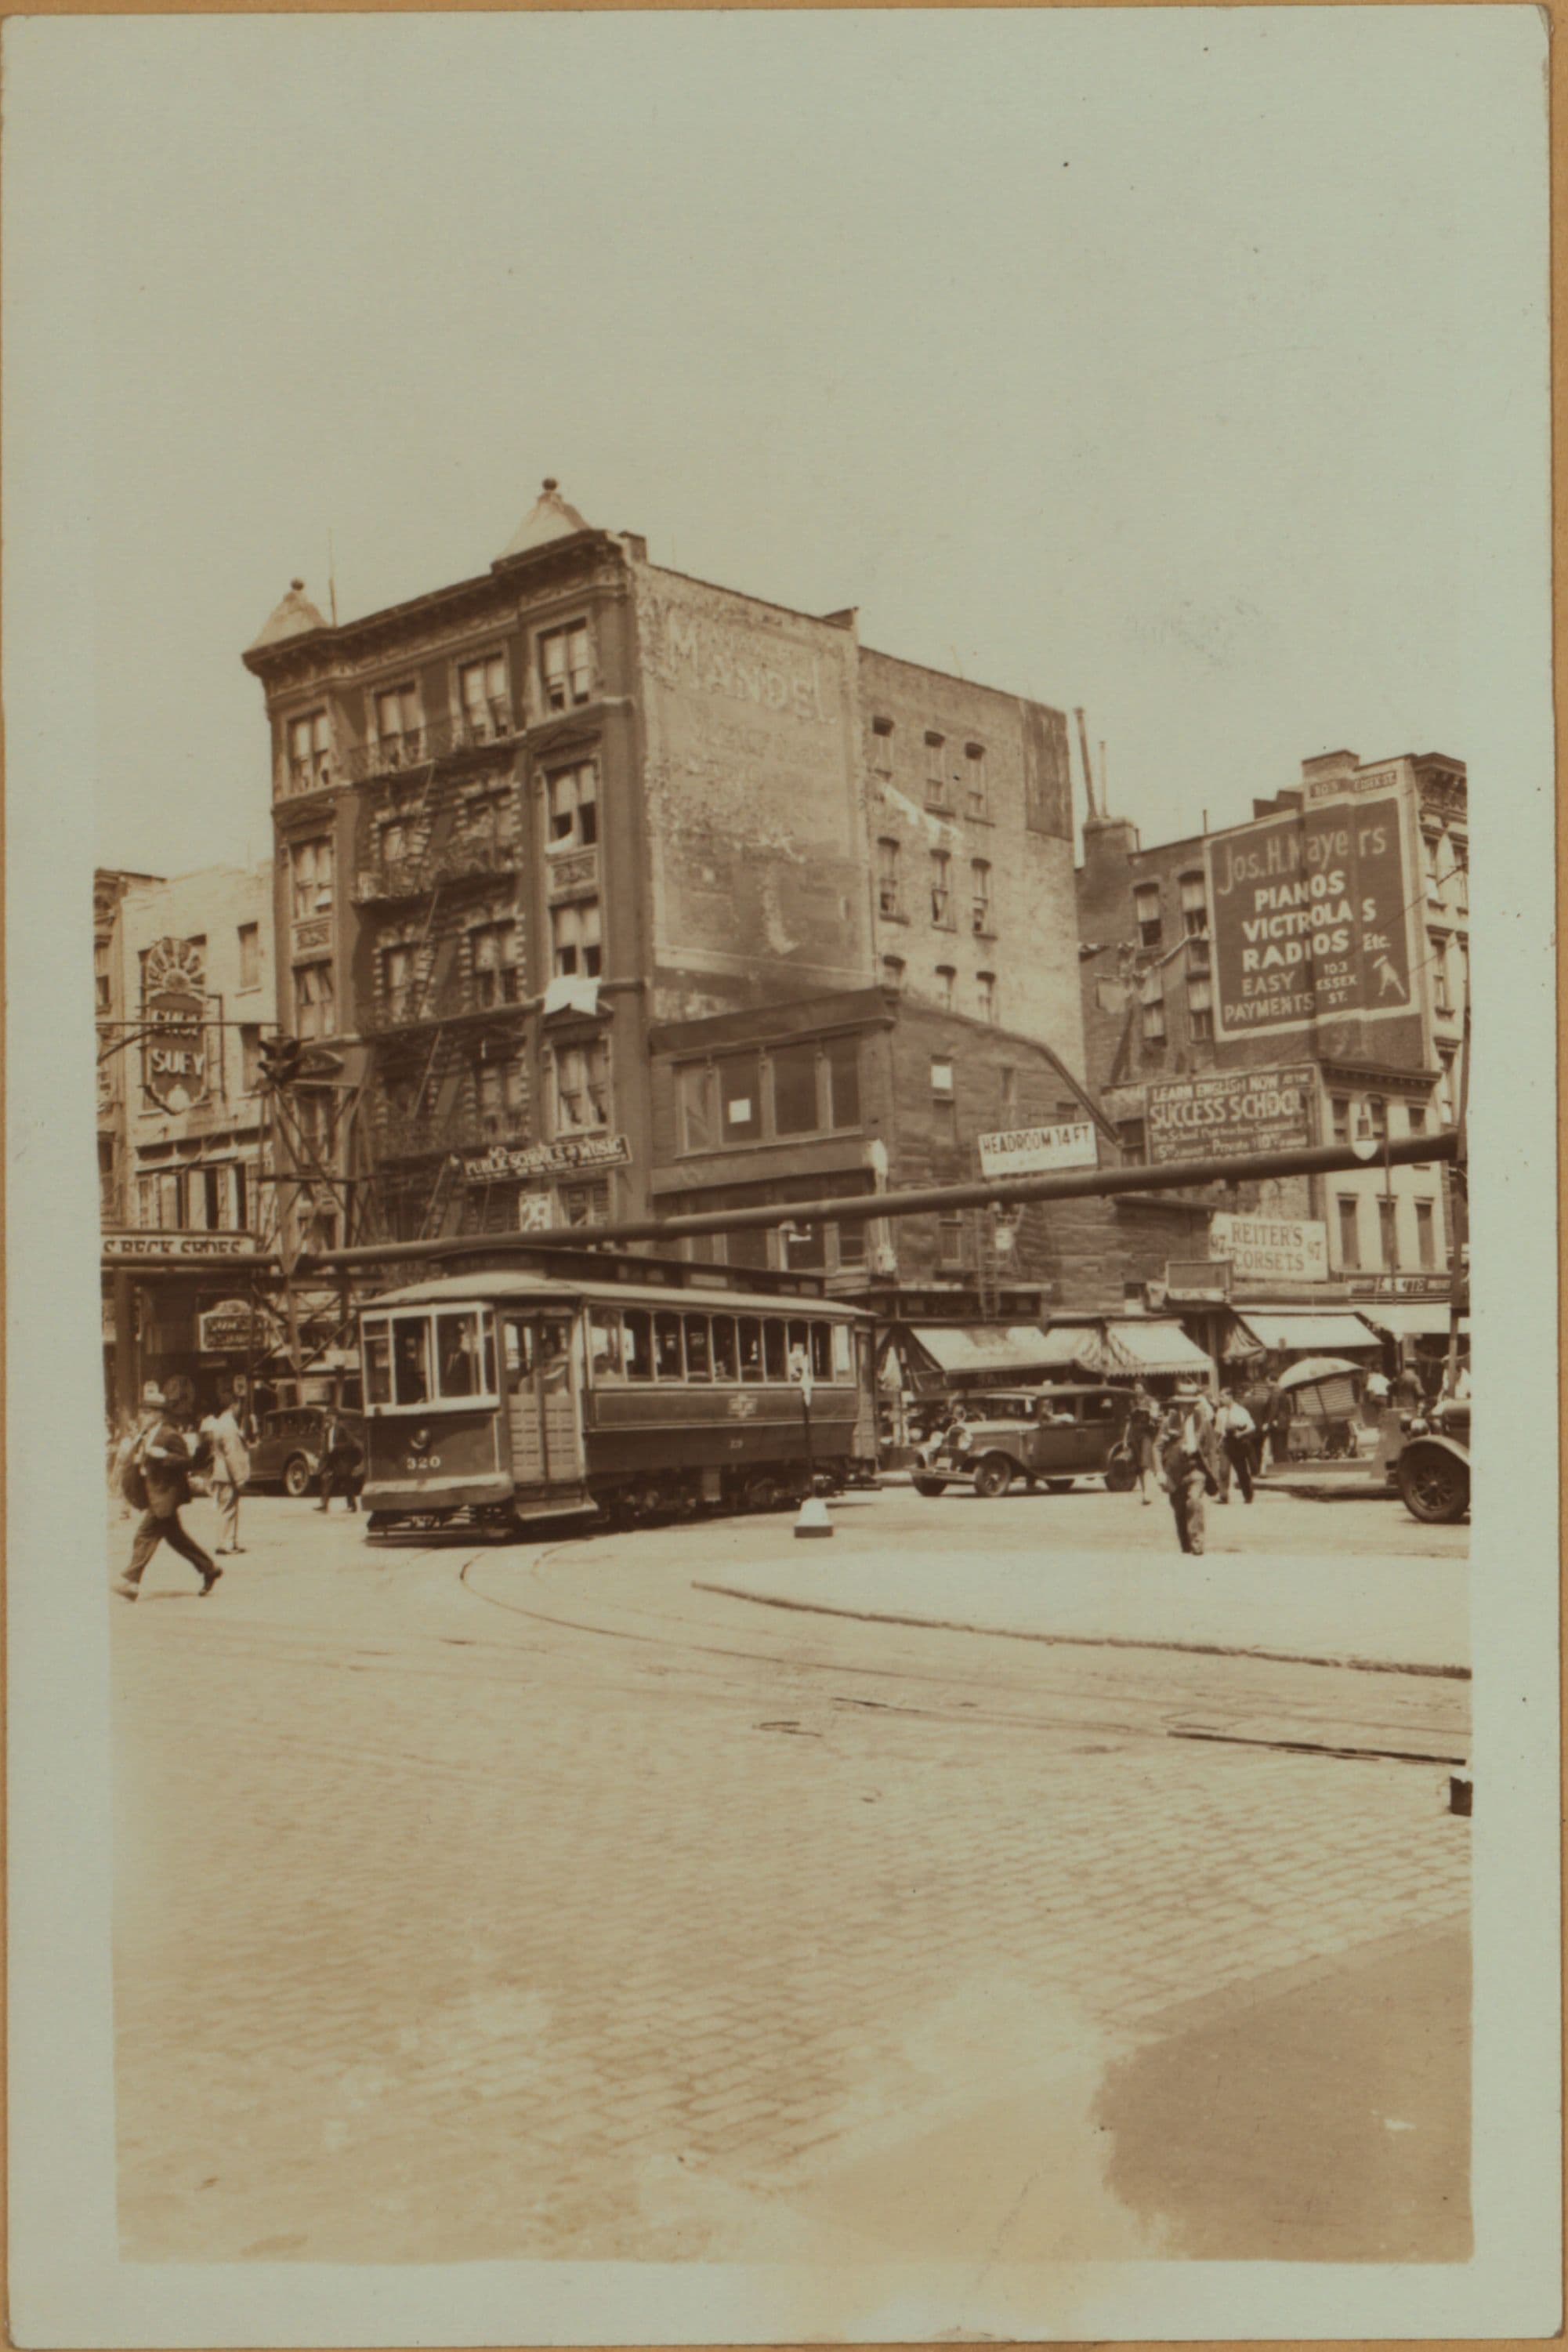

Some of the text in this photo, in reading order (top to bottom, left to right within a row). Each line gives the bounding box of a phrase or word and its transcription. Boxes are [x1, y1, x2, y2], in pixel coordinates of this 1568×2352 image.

[1255, 870, 1345, 911] PIANOS
[1241, 898, 1377, 942] VICTROLAS
[1242, 928, 1349, 972] RADIOS
[1324, 962, 1349, 974] 103
[1241, 971, 1295, 997] EASY
[1316, 974, 1357, 991] ESSEX
[1224, 992, 1315, 1023] PAYMENTS
[1327, 991, 1348, 1004] ST.
[151, 1049, 206, 1075] SUEY
[1152, 1085, 1193, 1103] LEARN
[1196, 1078, 1247, 1097] ENGLISH
[1249, 1073, 1280, 1092] NOW
[1150, 1088, 1305, 1130] SUCCESS SCHOOL
[983, 1131, 1052, 1154] HEADROOM
[1056, 1128, 1070, 1146] 14
[465, 1156, 509, 1176] PUBLIC
[509, 1144, 565, 1169] SCHOOLS
[578, 1136, 623, 1160] MUSIC
[179, 1241, 241, 1253] SHOES
[1231, 1222, 1303, 1248] REITER'S
[1233, 1248, 1305, 1271] CORSETS
[407, 1455, 440, 1470] 320
